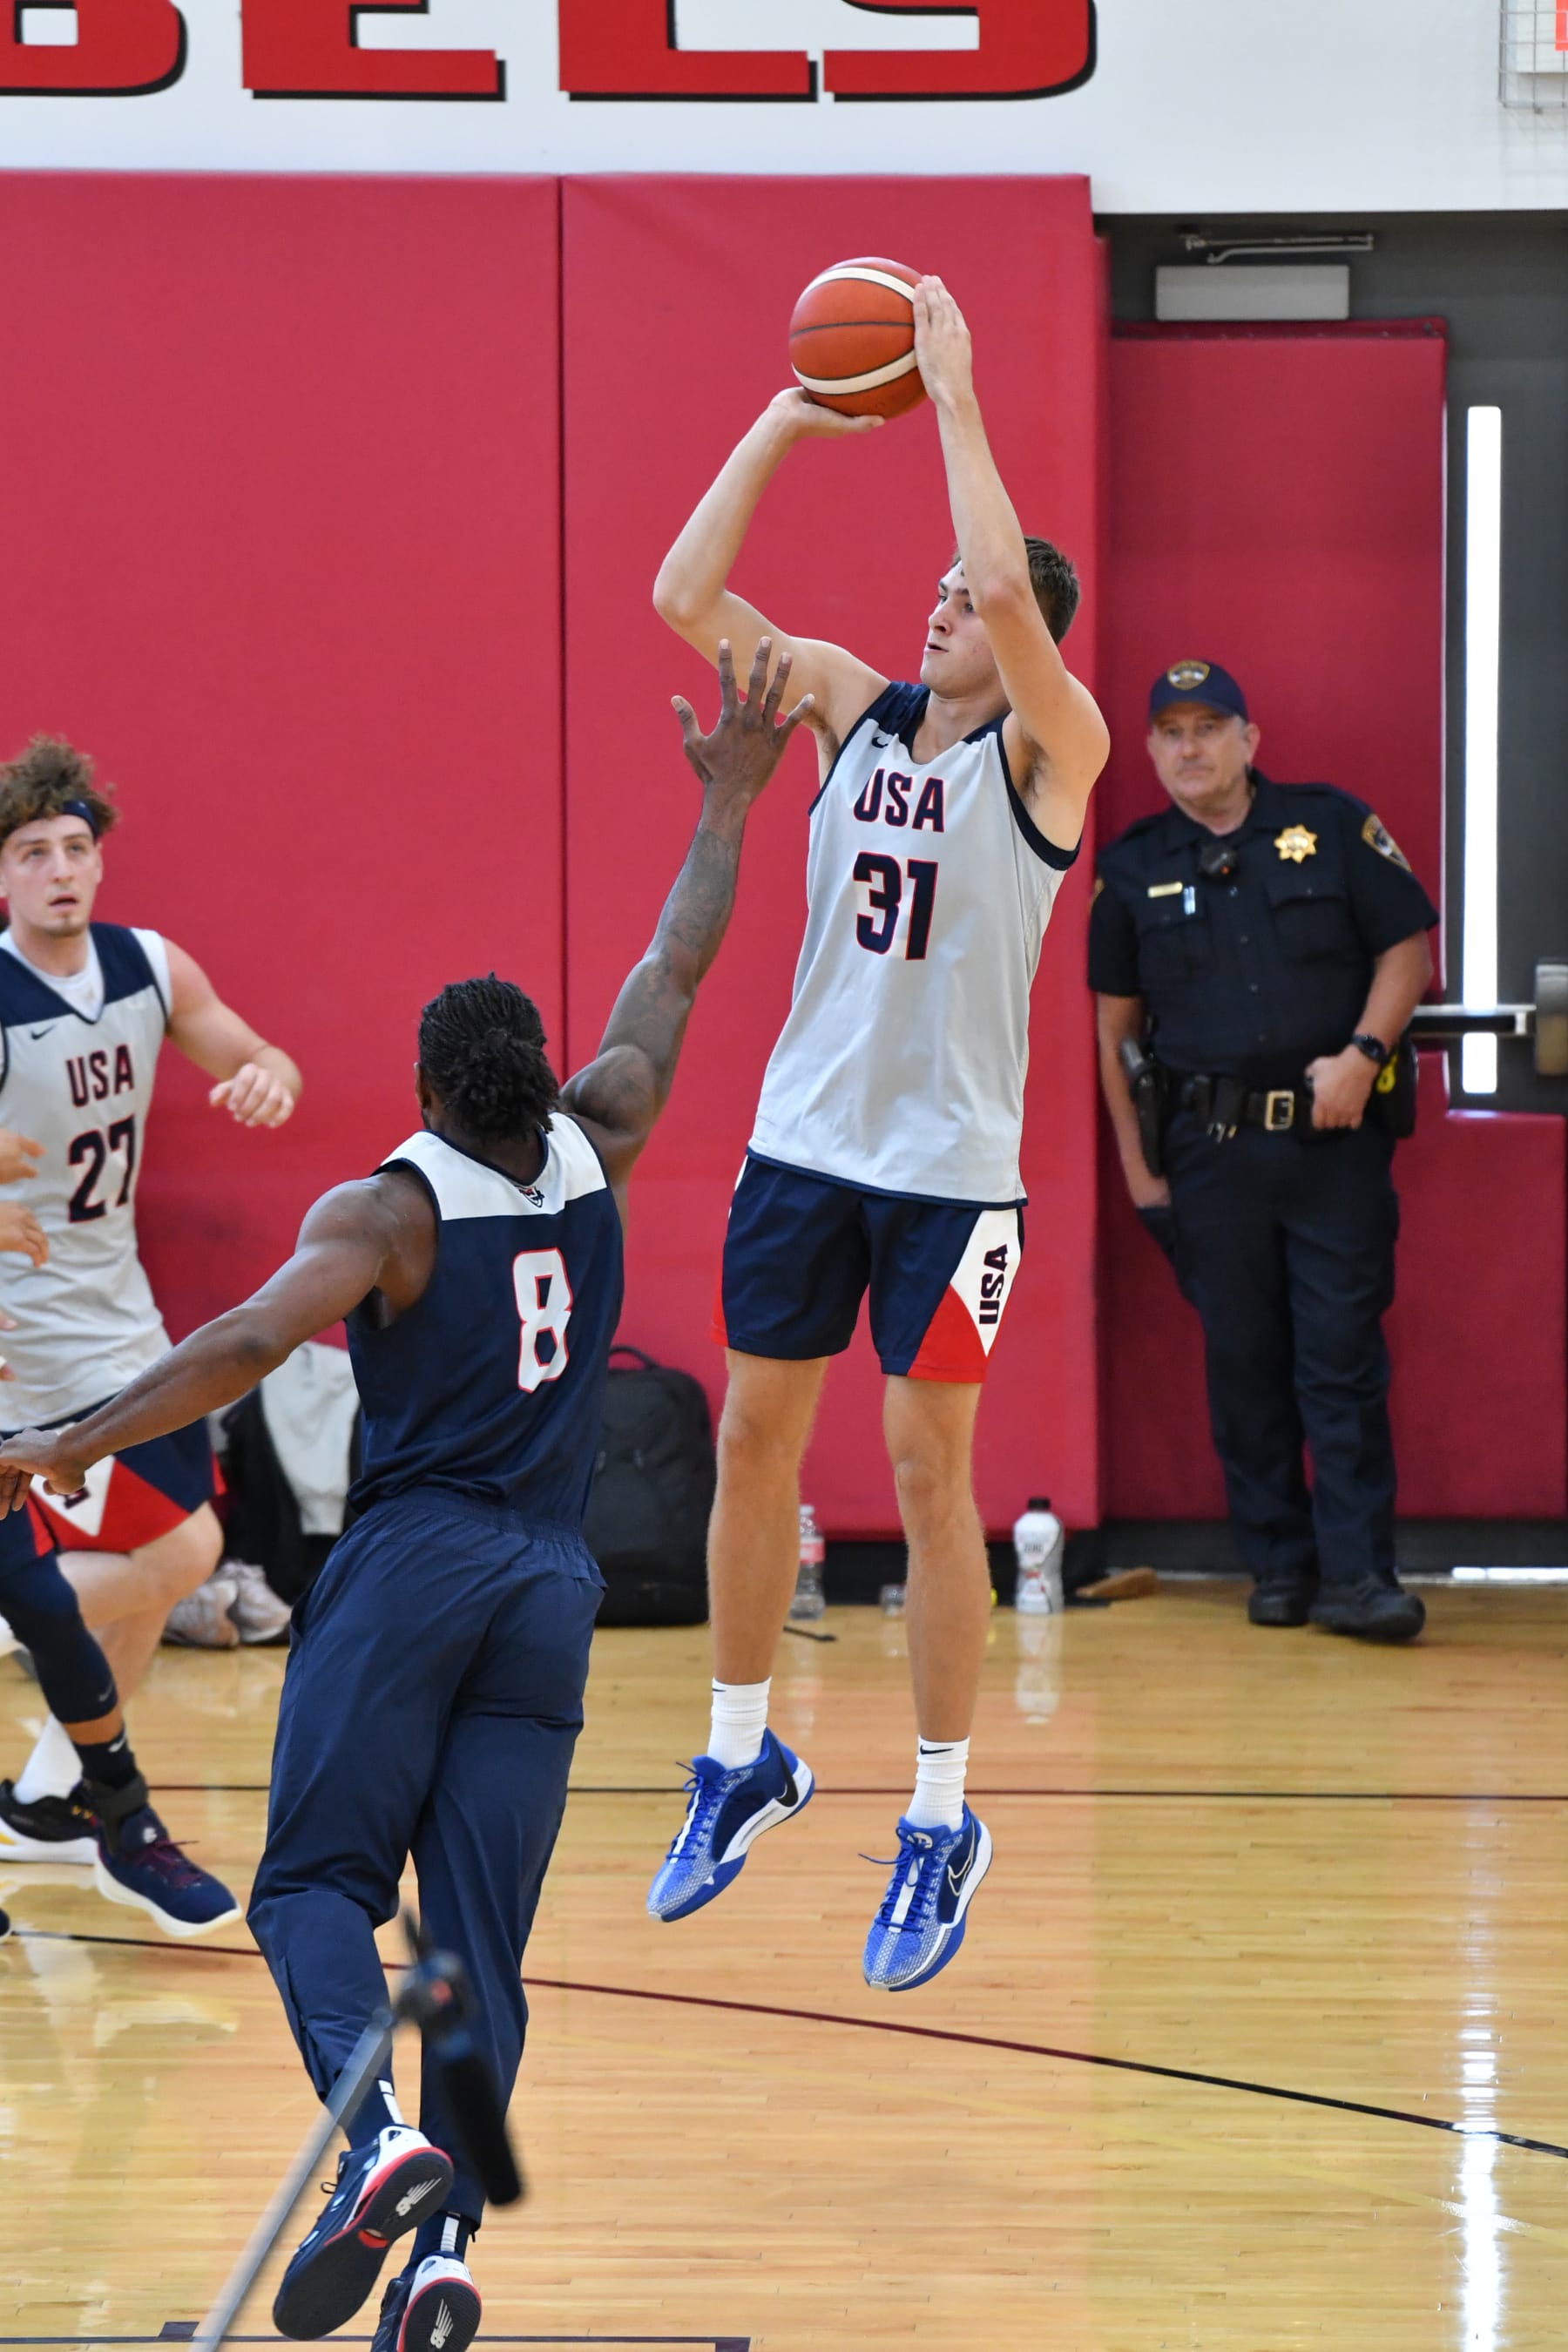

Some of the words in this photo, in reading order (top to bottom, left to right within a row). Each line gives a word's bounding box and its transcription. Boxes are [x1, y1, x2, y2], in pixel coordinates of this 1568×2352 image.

[853, 768, 944, 832] USA
[853, 850, 939, 960] 31
[65, 1044, 134, 1107] USA
[67, 1114, 135, 1223] 27
[512, 1247, 573, 1394] 8
[979, 1244, 1008, 1324] USA
